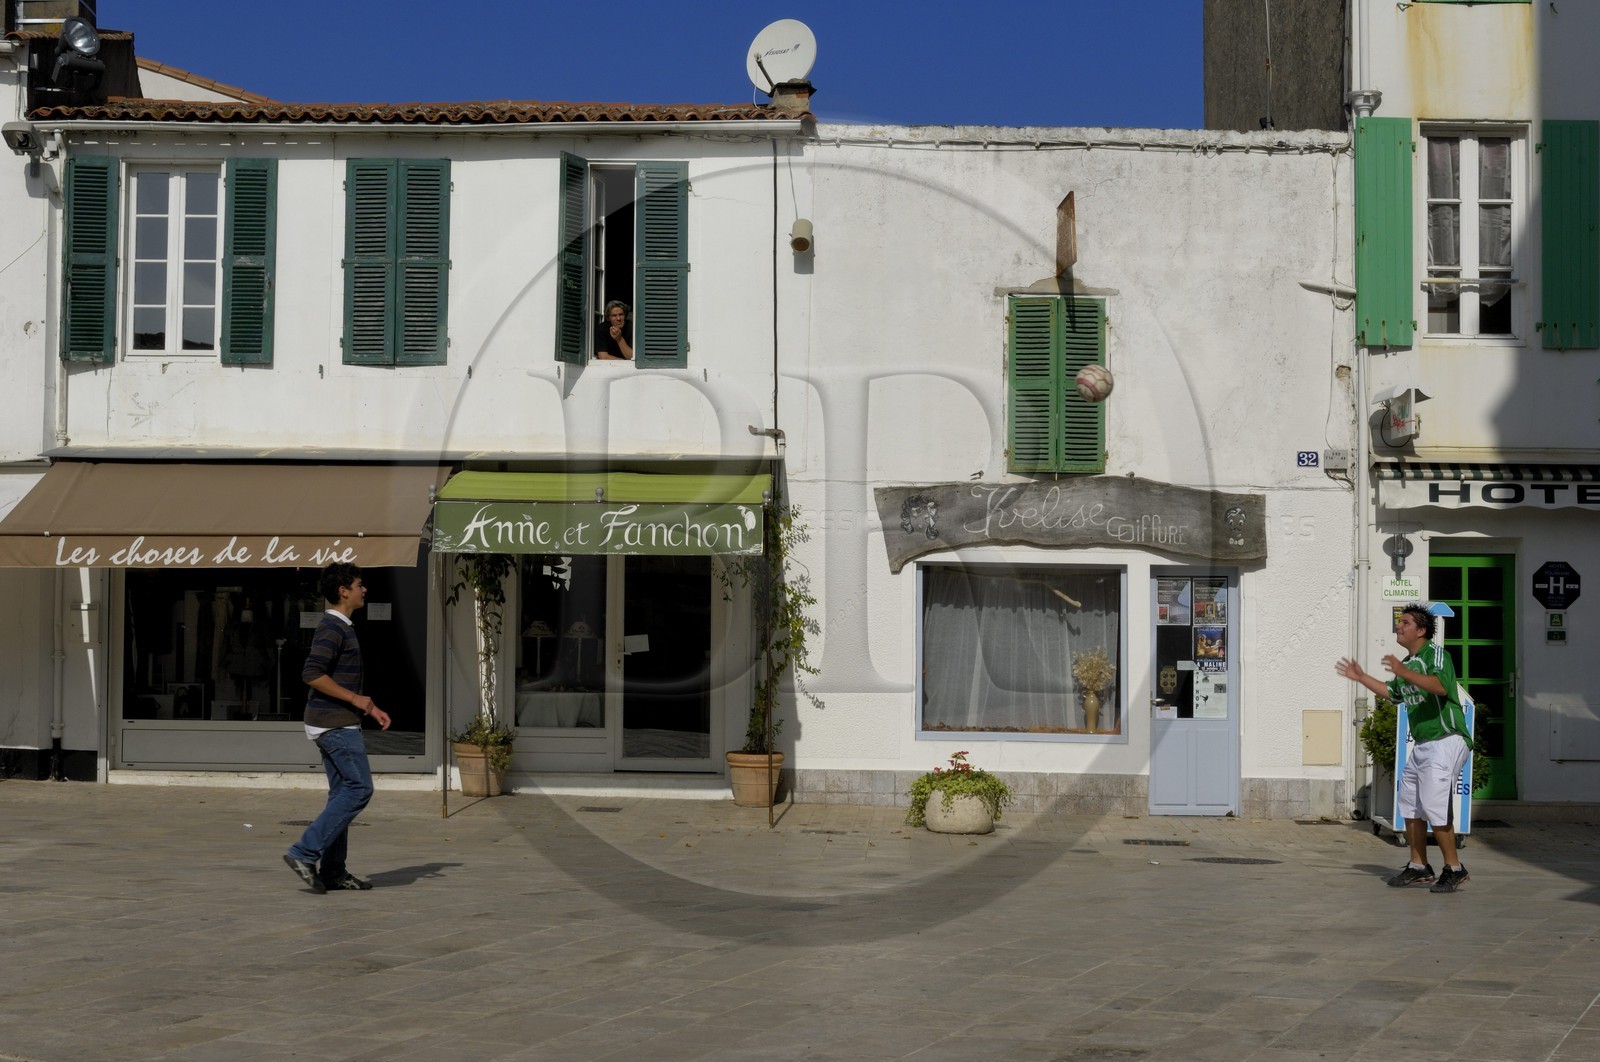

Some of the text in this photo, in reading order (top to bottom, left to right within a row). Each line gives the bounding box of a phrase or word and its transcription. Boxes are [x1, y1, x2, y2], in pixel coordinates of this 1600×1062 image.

[1299, 452, 1317, 466] 32
[456, 503, 743, 548] Anne et Fanchon
[56, 536, 358, 566] Les choses de la vie
[1390, 579, 1413, 587] HOTEL
[1549, 576, 1564, 594] H
[1383, 589, 1419, 597] CLIMATISE
